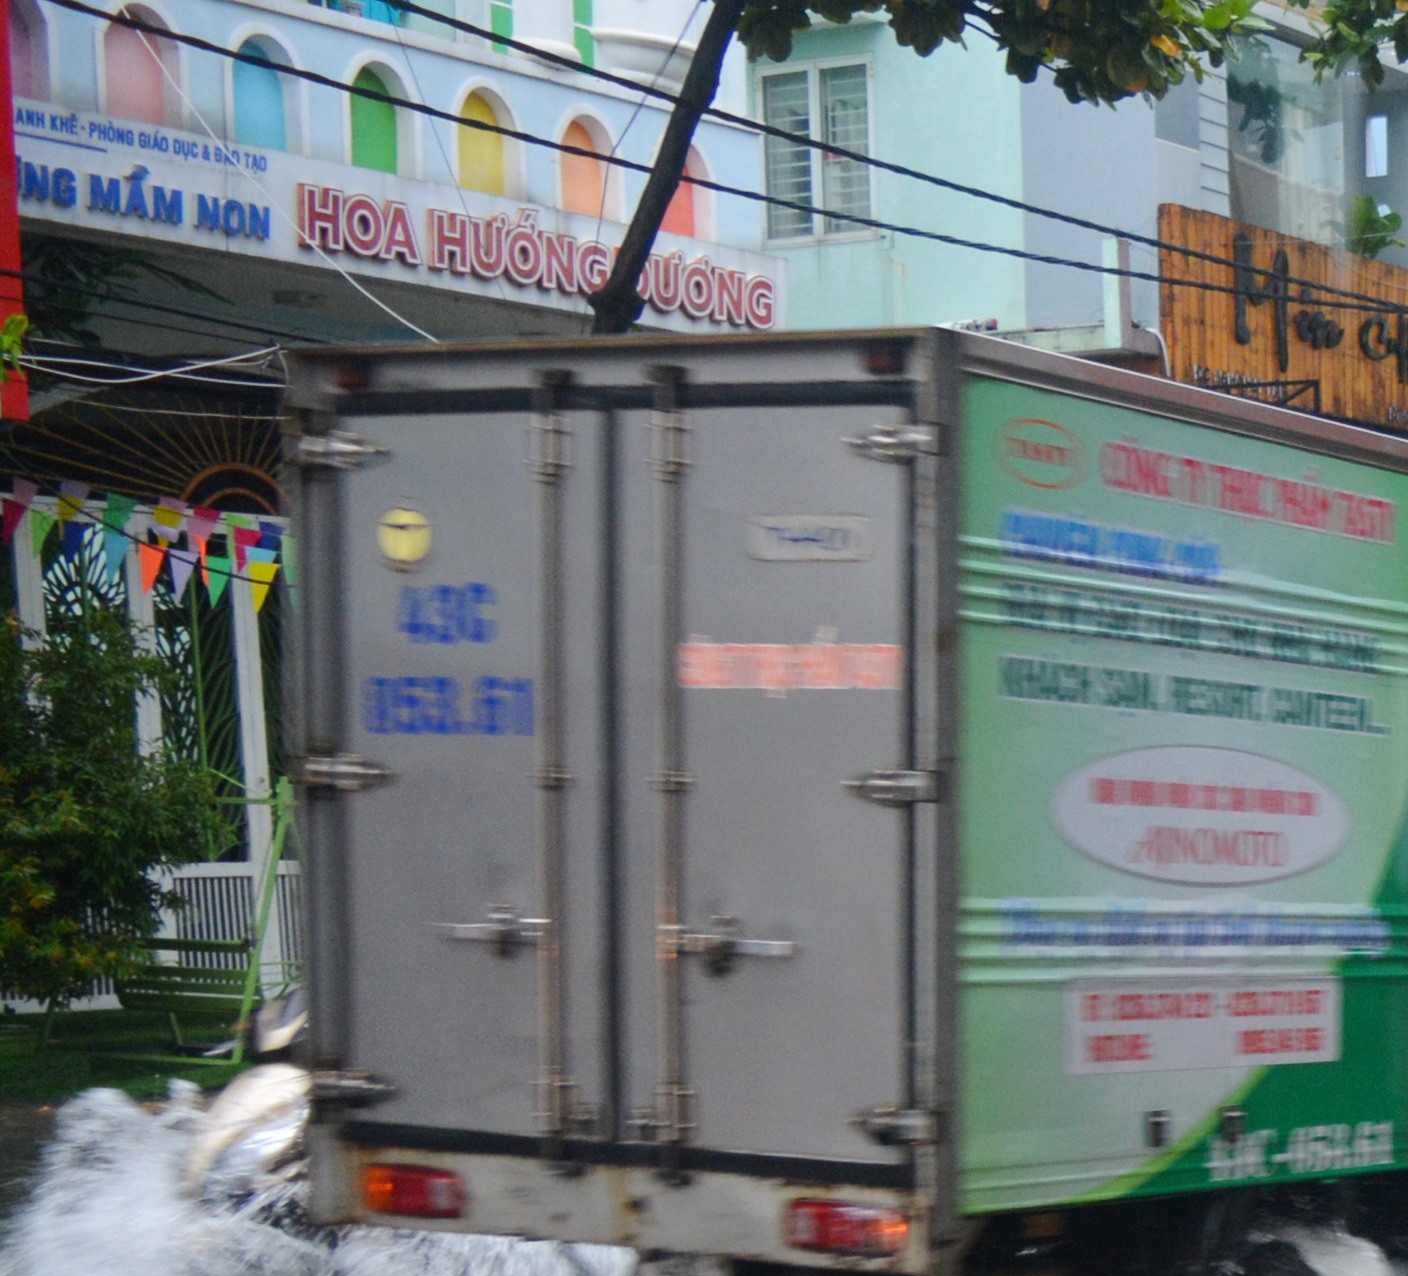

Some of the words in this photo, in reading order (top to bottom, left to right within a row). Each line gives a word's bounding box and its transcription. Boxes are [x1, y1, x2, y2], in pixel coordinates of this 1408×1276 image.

[50, 114, 78, 136] KHÊ
[88, 122, 135, 146] PHÒNG
[138, 134, 169, 153] GIÁO
[173, 142, 198, 162] DỤC
[202, 149, 210, 161] &
[243, 152, 267, 174] TẠO
[17, 156, 78, 208] NG
[192, 191, 271, 241] NON
[298, 182, 421, 265] HOA
[428, 207, 610, 296] HƯỚNG
